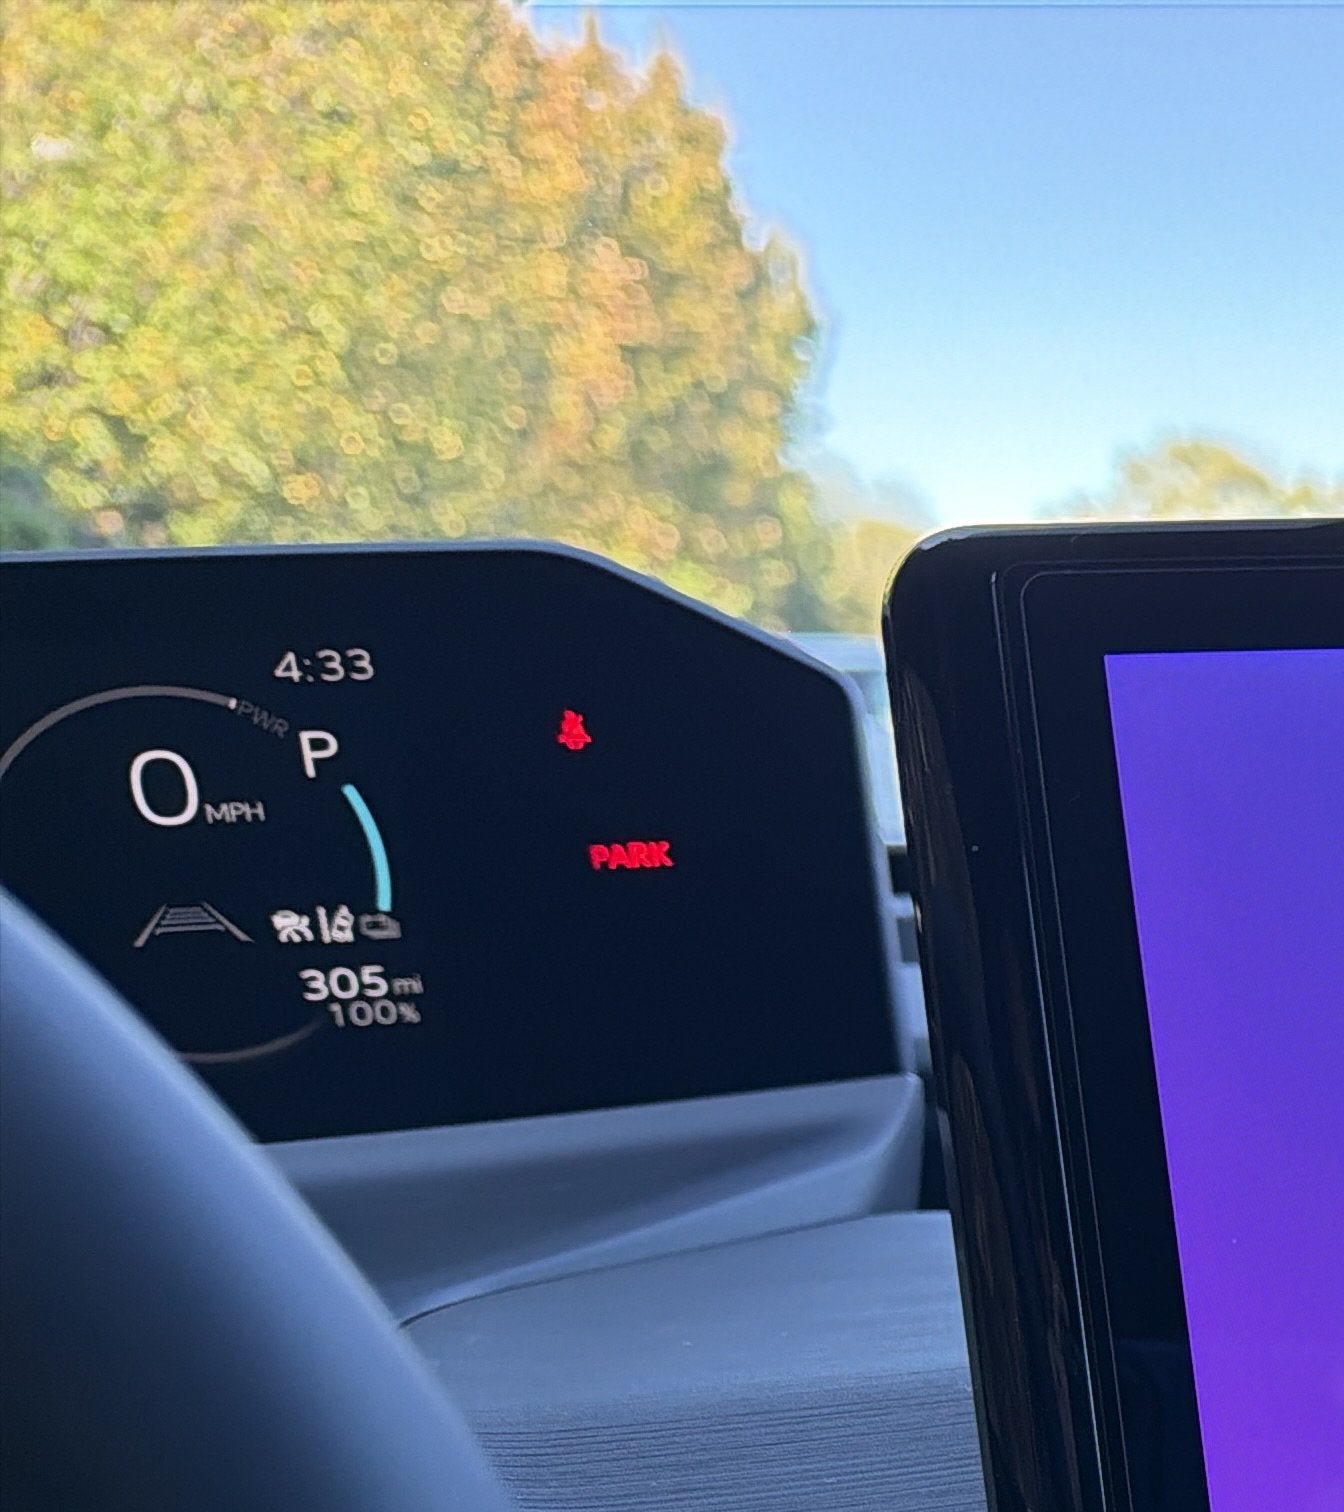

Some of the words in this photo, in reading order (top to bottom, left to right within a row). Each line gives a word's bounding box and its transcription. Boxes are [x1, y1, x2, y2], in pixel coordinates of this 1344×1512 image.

[273, 648, 375, 683] 4:33
[236, 700, 290, 740] PWR
[299, 730, 339, 779] P
[204, 800, 266, 825] MPH
[589, 840, 675, 871] PARK
[299, 964, 389, 1001] 305
[328, 999, 422, 1029] 100%
